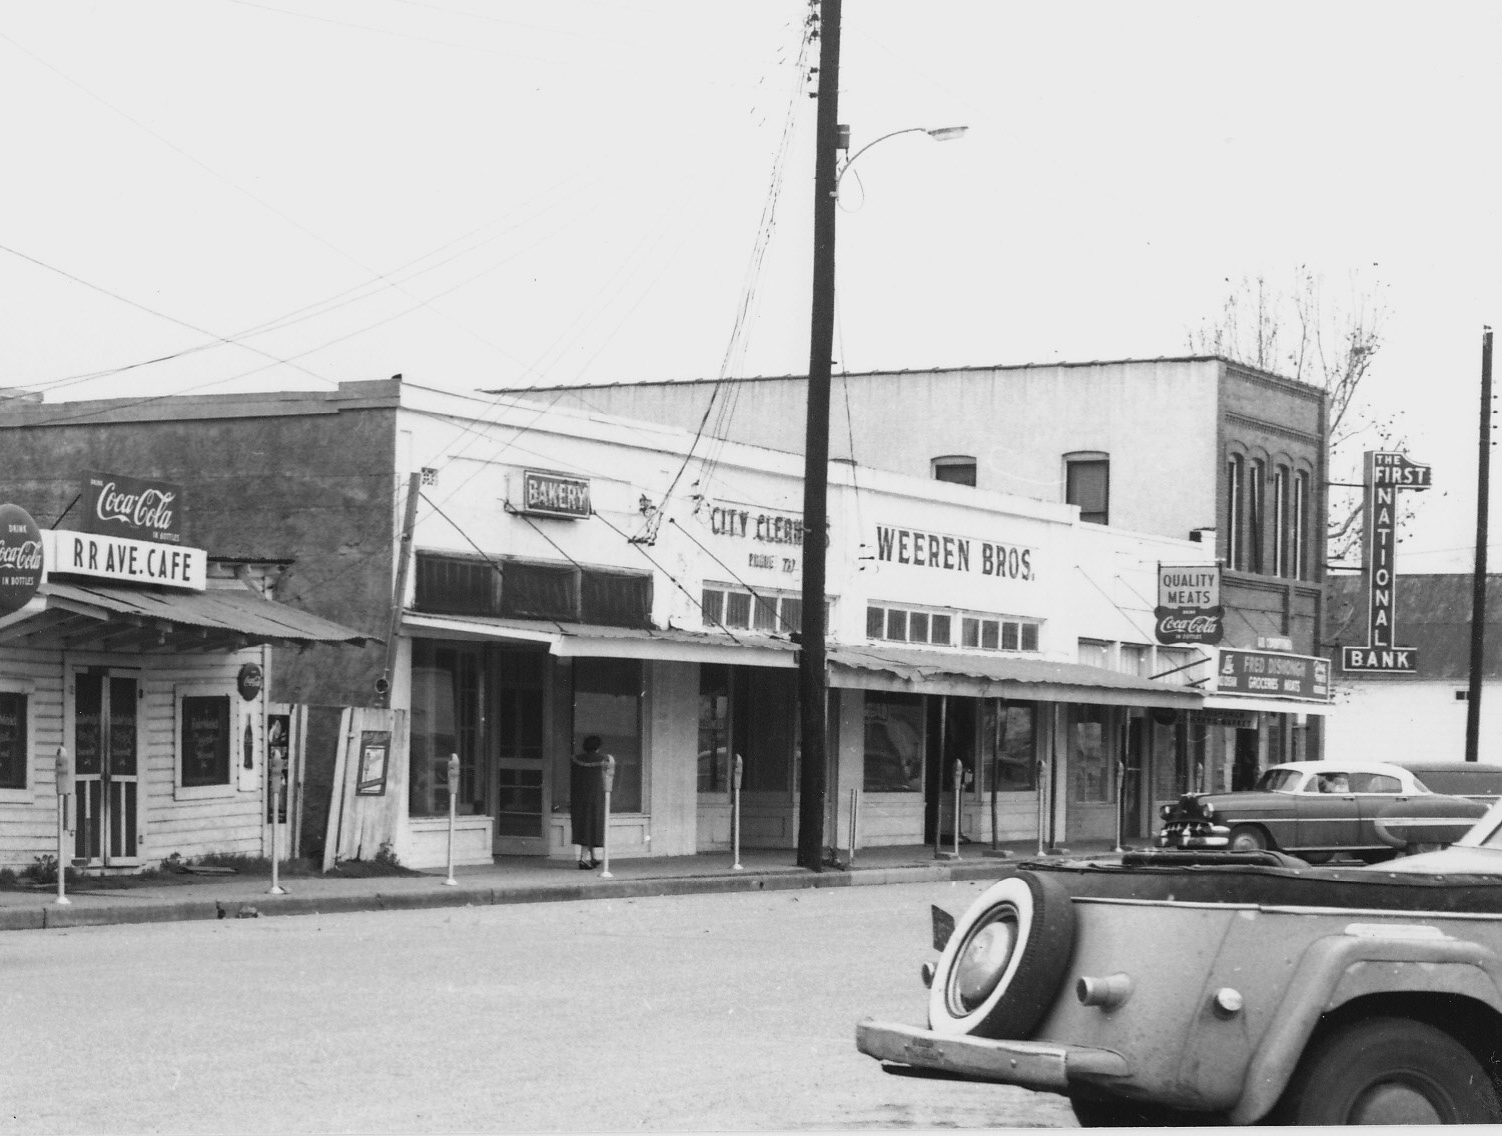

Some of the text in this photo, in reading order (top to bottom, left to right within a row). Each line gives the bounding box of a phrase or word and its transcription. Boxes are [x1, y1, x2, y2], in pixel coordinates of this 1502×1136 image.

[1376, 455, 1402, 465] THE
[1375, 466, 1426, 484] FIRST
[528, 479, 588, 510] BAKERY
[97, 481, 176, 529] Coca-Cola
[8, 524, 28, 534] DRINK
[712, 506, 749, 538] CITY
[877, 526, 1036, 581] WEEREN BROS.
[1374, 487, 1392, 647] NATIONAL
[1, 576, 35, 586] IN BOTTLES
[1163, 574, 1215, 588] QUALITY
[1168, 591, 1211, 604] MEATS
[1160, 615, 1219, 635] Coca-Cola
[1351, 651, 1409, 668] BANK
